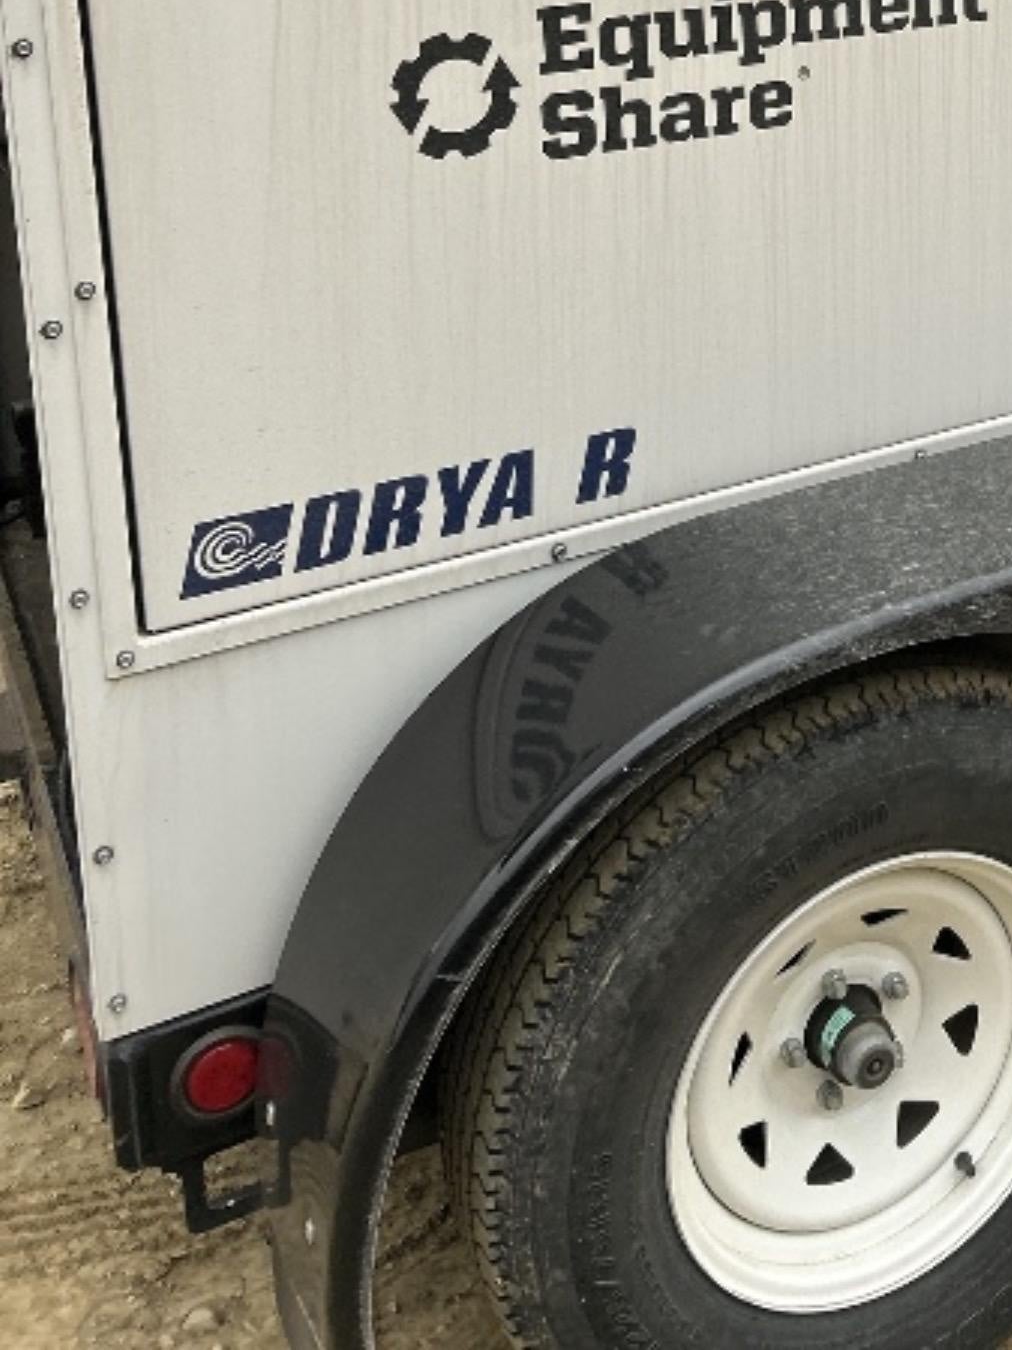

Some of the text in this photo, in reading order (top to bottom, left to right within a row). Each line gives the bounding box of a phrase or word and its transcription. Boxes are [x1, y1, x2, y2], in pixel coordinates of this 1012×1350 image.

[540, 79, 793, 160] Share
[293, 428, 637, 574] DRYA R
